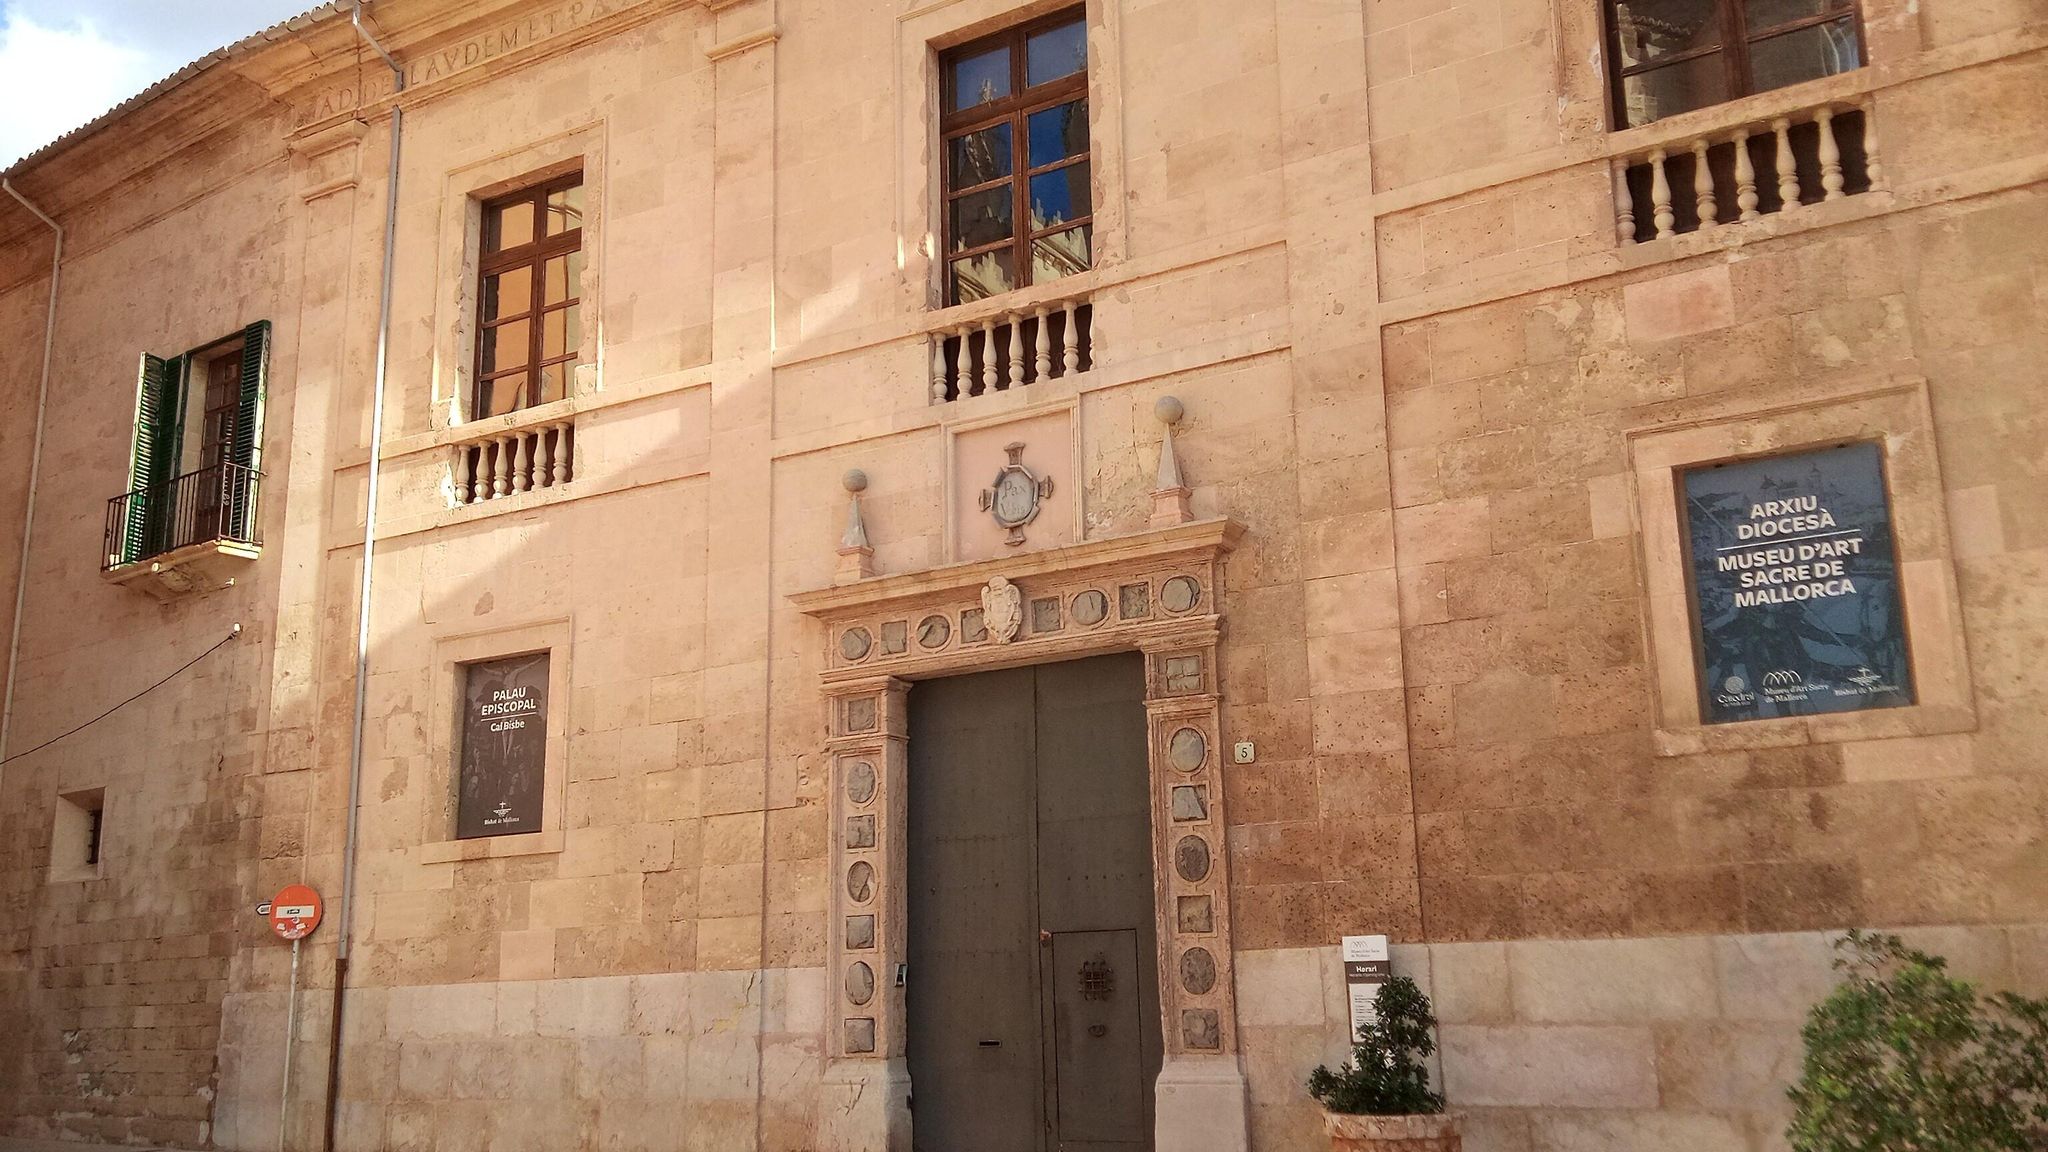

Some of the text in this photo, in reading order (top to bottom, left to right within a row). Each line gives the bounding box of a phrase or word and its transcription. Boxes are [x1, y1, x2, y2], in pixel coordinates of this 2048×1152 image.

[1751, 495, 1817, 519] ARXIU
[1737, 507, 1836, 540] DIOCESÀ
[1718, 547, 1795, 571] MUSEU
[1740, 560, 1845, 588] SACRE DE
[1735, 578, 1857, 607] MALLORCA
[493, 686, 526, 701] PALAU
[481, 698, 536, 716] EPISCOPAL
[490, 719, 525, 732] Cal Bisbe
[1241, 747, 1248, 758] 5
